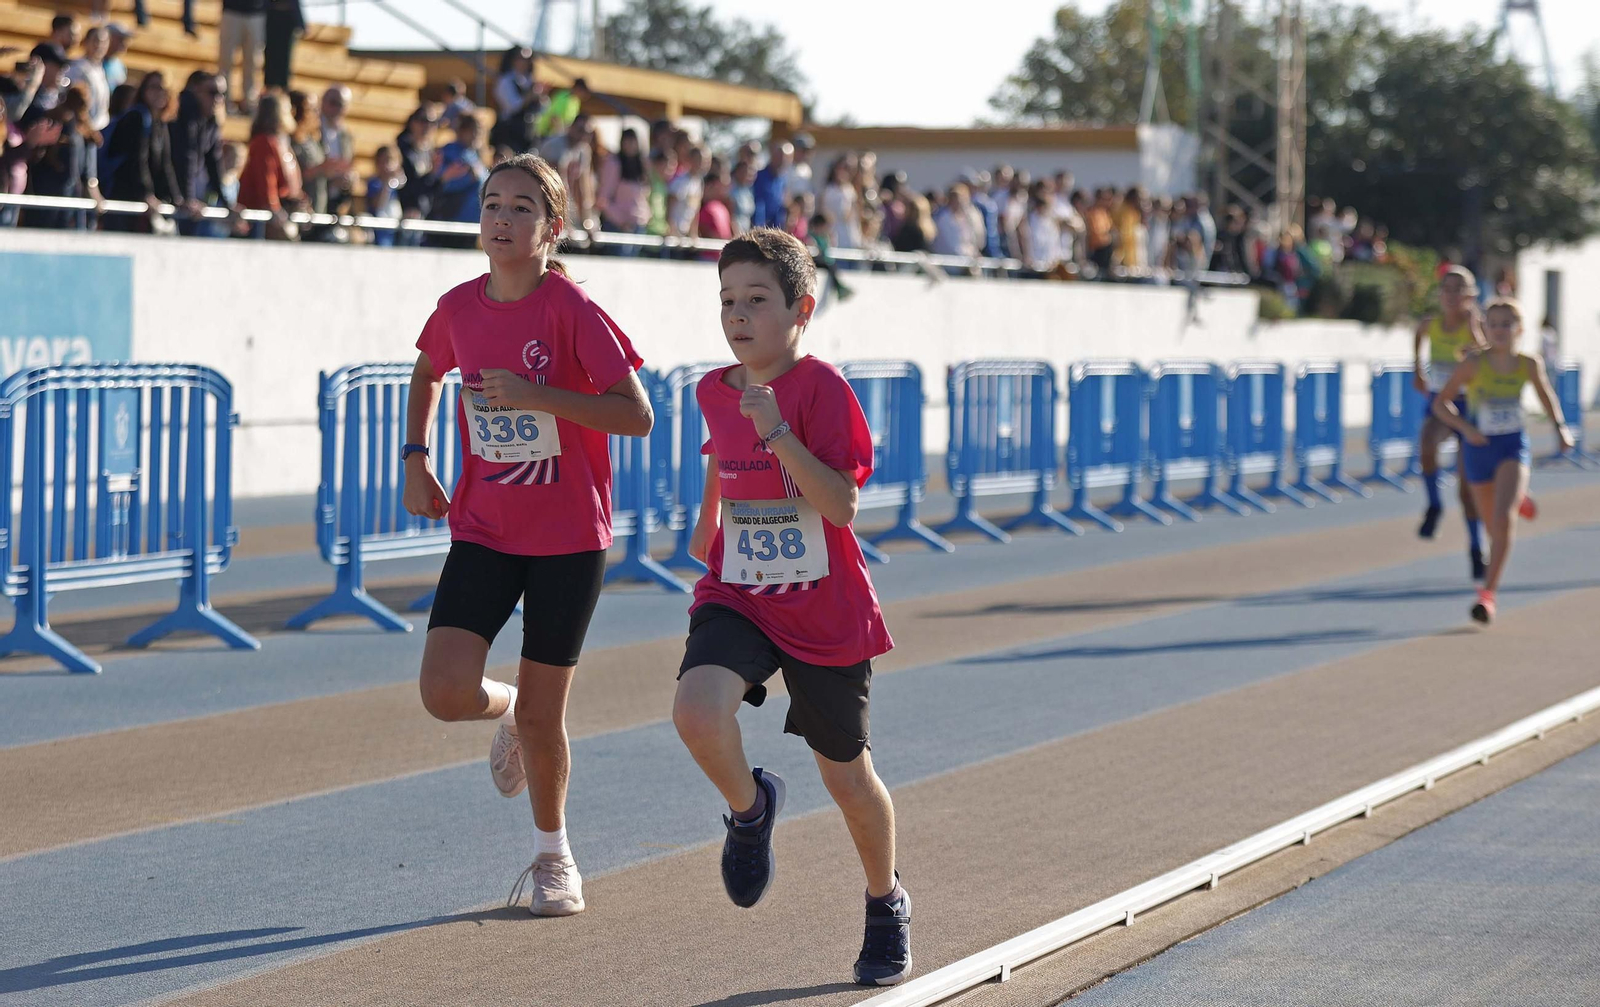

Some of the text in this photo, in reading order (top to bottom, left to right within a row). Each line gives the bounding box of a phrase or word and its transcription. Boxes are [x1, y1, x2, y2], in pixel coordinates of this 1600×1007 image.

[474, 414, 540, 442] 336
[732, 516, 752, 524] CIUDAD
[762, 514, 799, 524] ALGECIRAS
[761, 505, 798, 516] URBANA
[737, 528, 806, 562] 438
